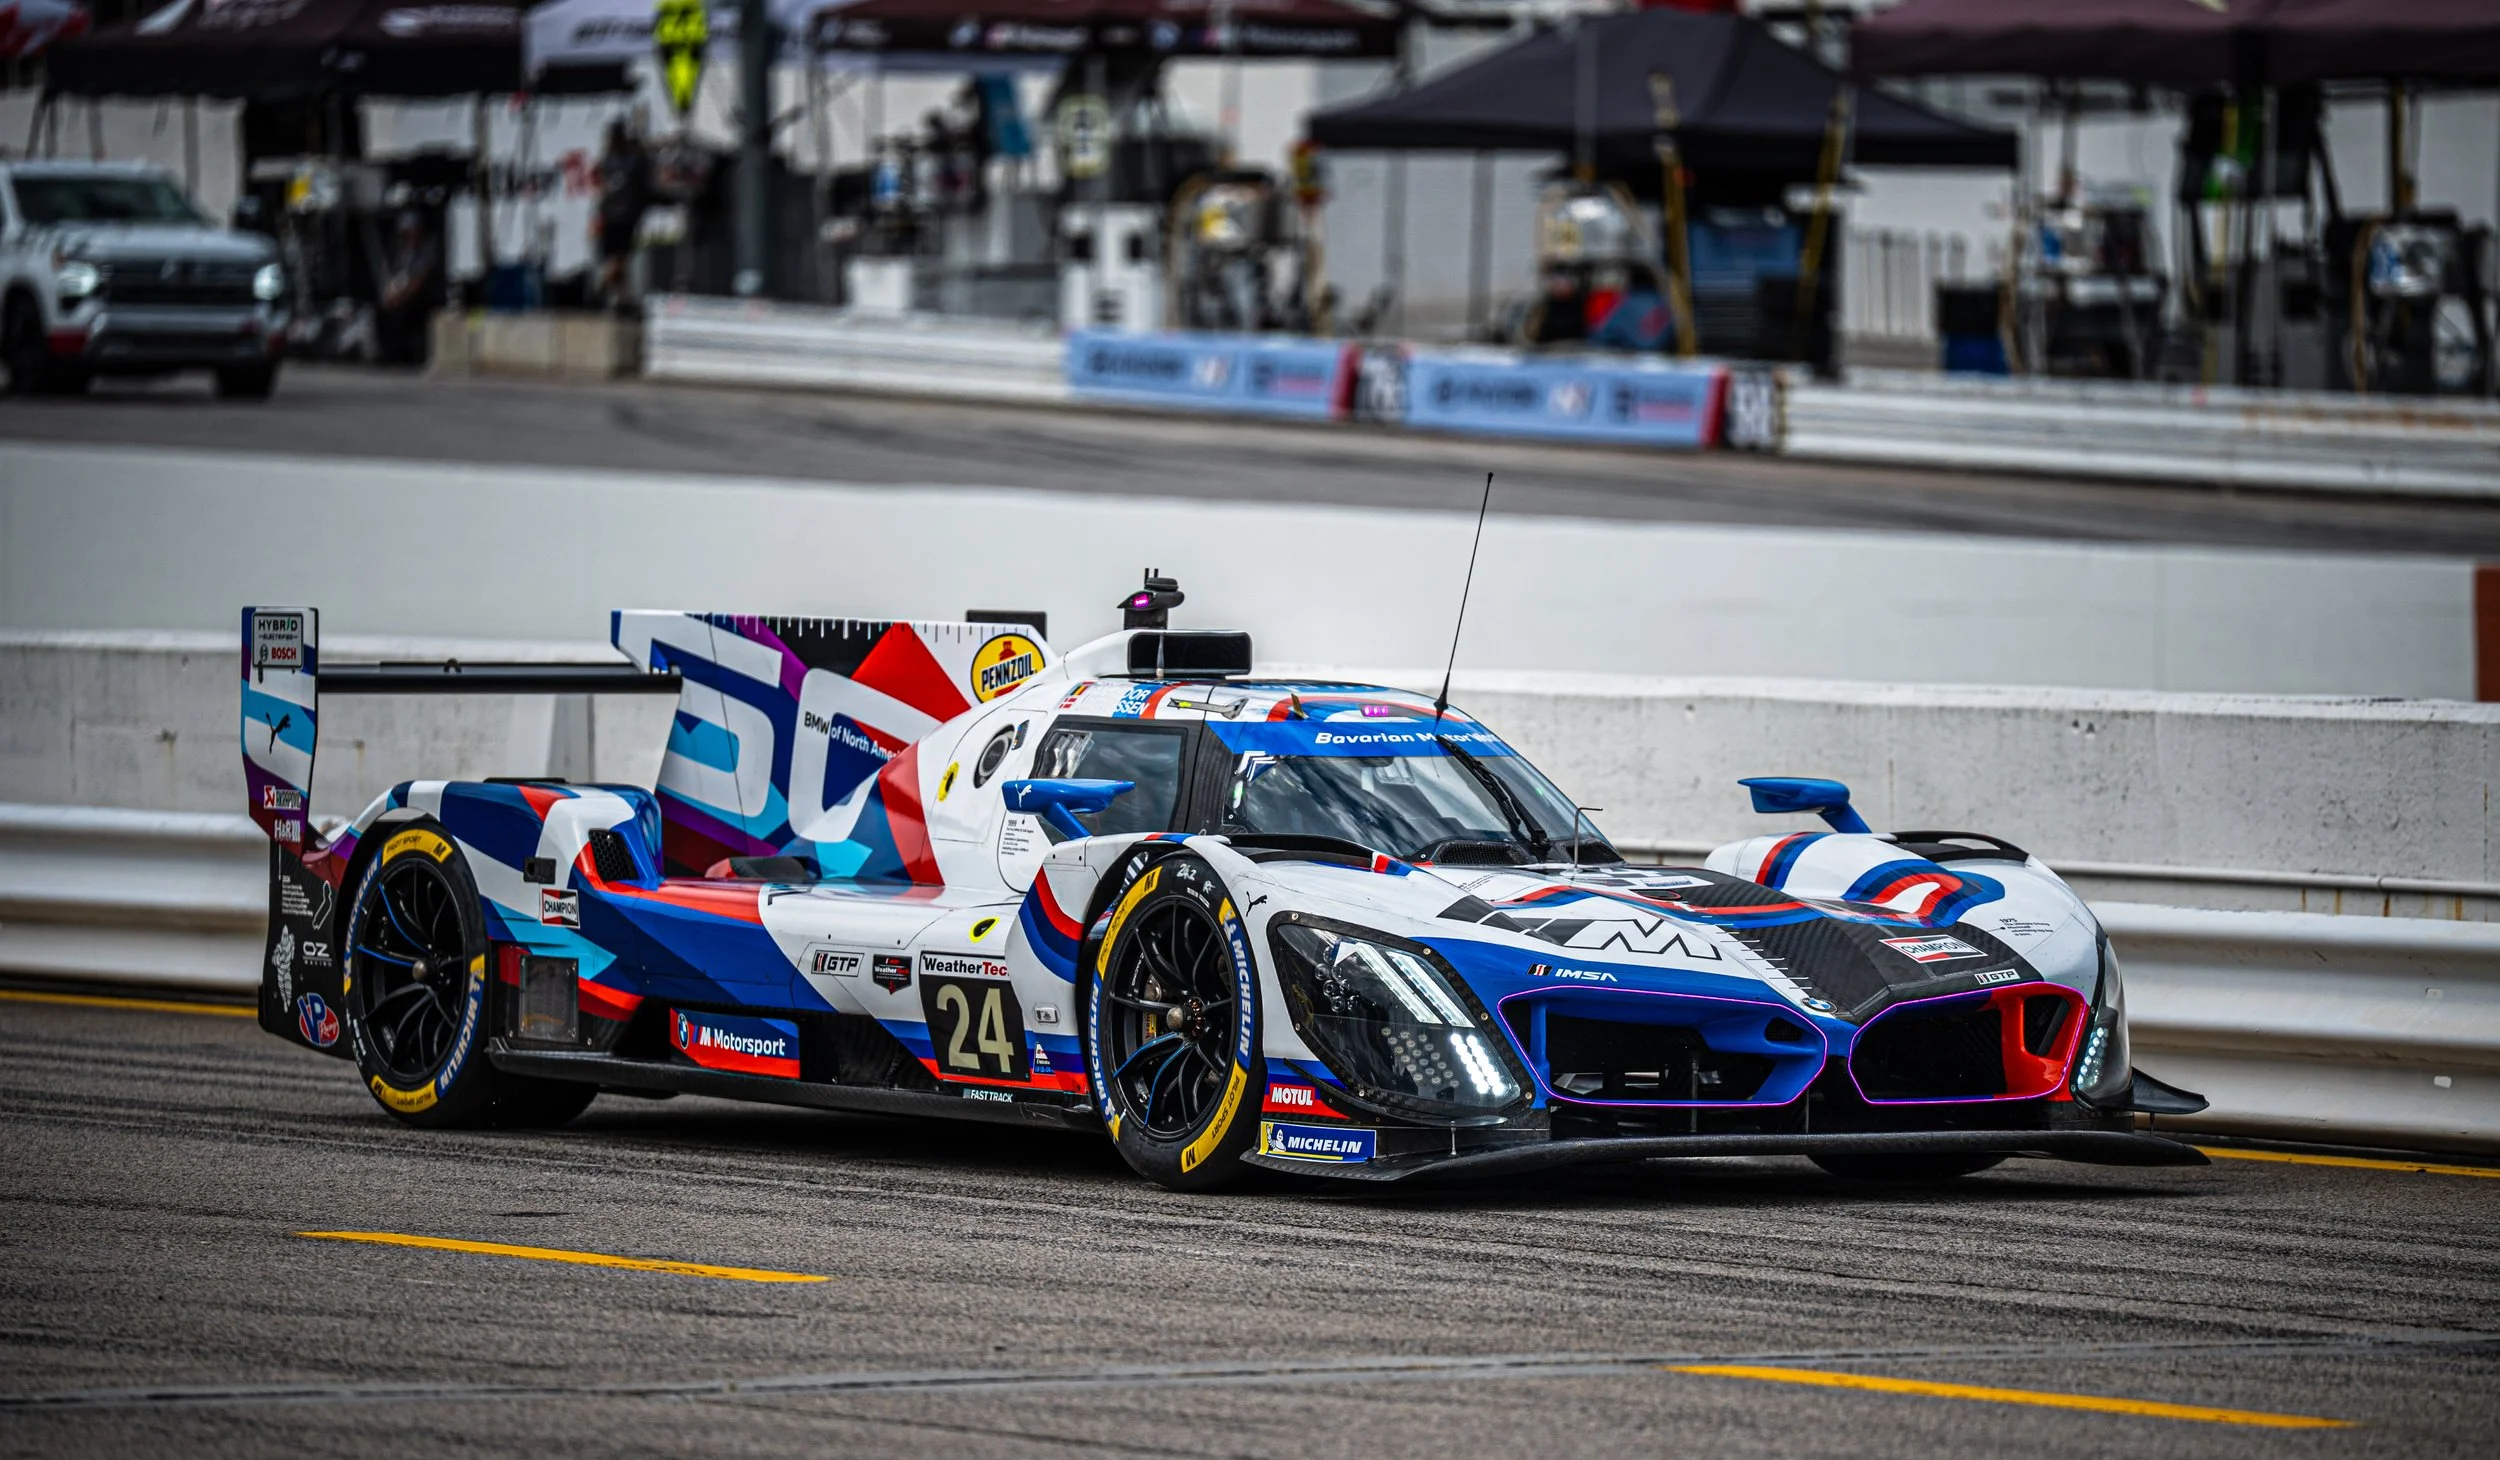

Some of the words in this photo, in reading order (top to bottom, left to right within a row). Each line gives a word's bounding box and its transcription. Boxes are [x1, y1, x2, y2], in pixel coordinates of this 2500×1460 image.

[258, 617, 298, 631] HYBRID
[271, 647, 297, 660] BOSCH
[981, 653, 1034, 693] PENNZOIL
[804, 711, 831, 735] BMW
[831, 725, 842, 740] of
[842, 730, 869, 752] North
[1315, 732, 1410, 744] Bavarian
[1416, 732, 1471, 743] Mtor
[433, 842, 447, 857] M
[1143, 871, 1156, 893] M
[544, 900, 577, 915] CHAMPION
[1900, 940, 1967, 954] CHAMPION
[827, 956, 859, 971] GTP
[923, 955, 1009, 977] WeatherTec
[1555, 968, 1618, 982] IMSA
[1990, 971, 2015, 980] GTP
[1232, 940, 1251, 1057] MICHELIN
[936, 984, 1015, 1073] 24
[440, 997, 479, 1091] MICHELIN
[714, 1028, 786, 1058] Motorsport
[1089, 983, 1107, 1100] MICHELIN
[970, 1089, 988, 1101] FAST
[988, 1091, 1013, 1103] TRACK
[1228, 1074, 1240, 1108] PILOT
[1271, 1087, 1314, 1106] MOTUL
[1211, 1108, 1229, 1139] SPORT
[1287, 1136, 1362, 1154] MICHELIN
[1185, 1147, 1196, 1167] M
